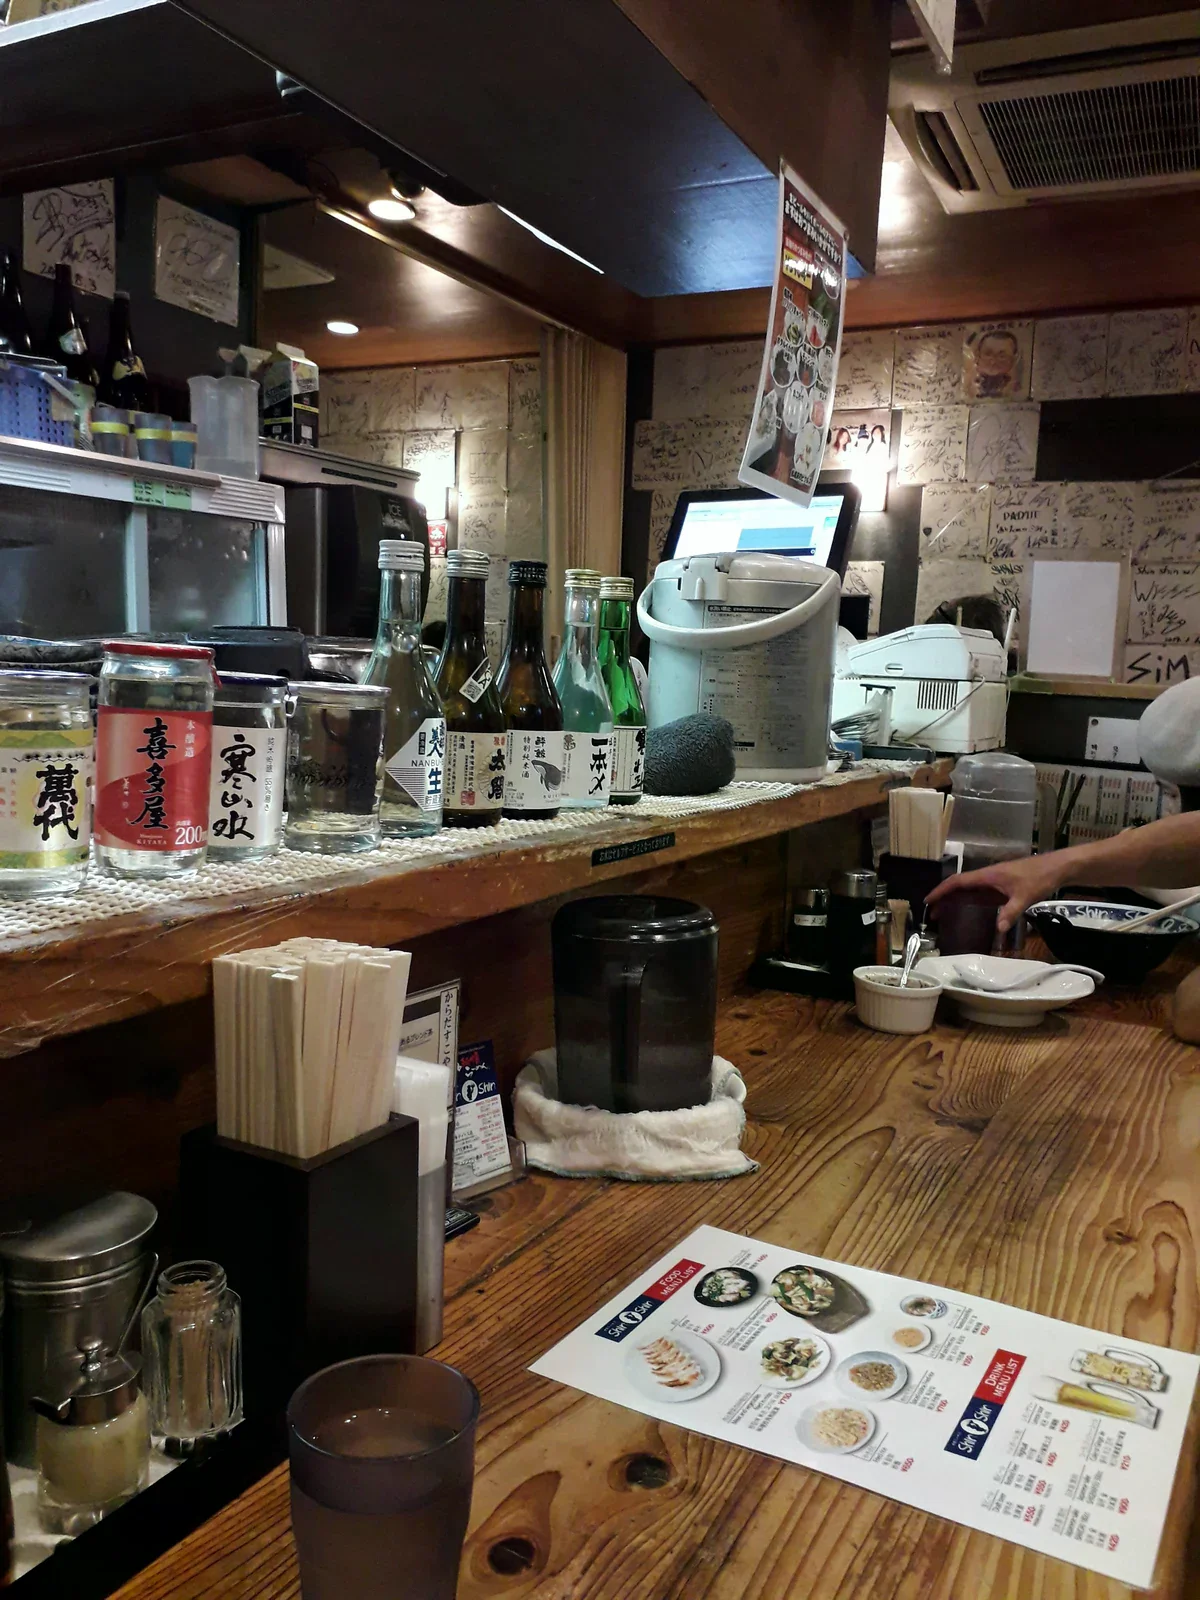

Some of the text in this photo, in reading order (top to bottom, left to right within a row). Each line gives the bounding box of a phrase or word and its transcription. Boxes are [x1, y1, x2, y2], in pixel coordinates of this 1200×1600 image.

[130, 717, 177, 829] 喜多屋
[427, 768, 442, 795] 生
[33, 763, 79, 841] 萬代
[659, 1265, 698, 1295] MENU LIST
[605, 1299, 656, 1337] Shin Shin
[983, 1361, 1006, 1386] DRINK
[992, 1357, 1020, 1397] MENU LIST
[955, 1402, 994, 1453] Shin Shin
